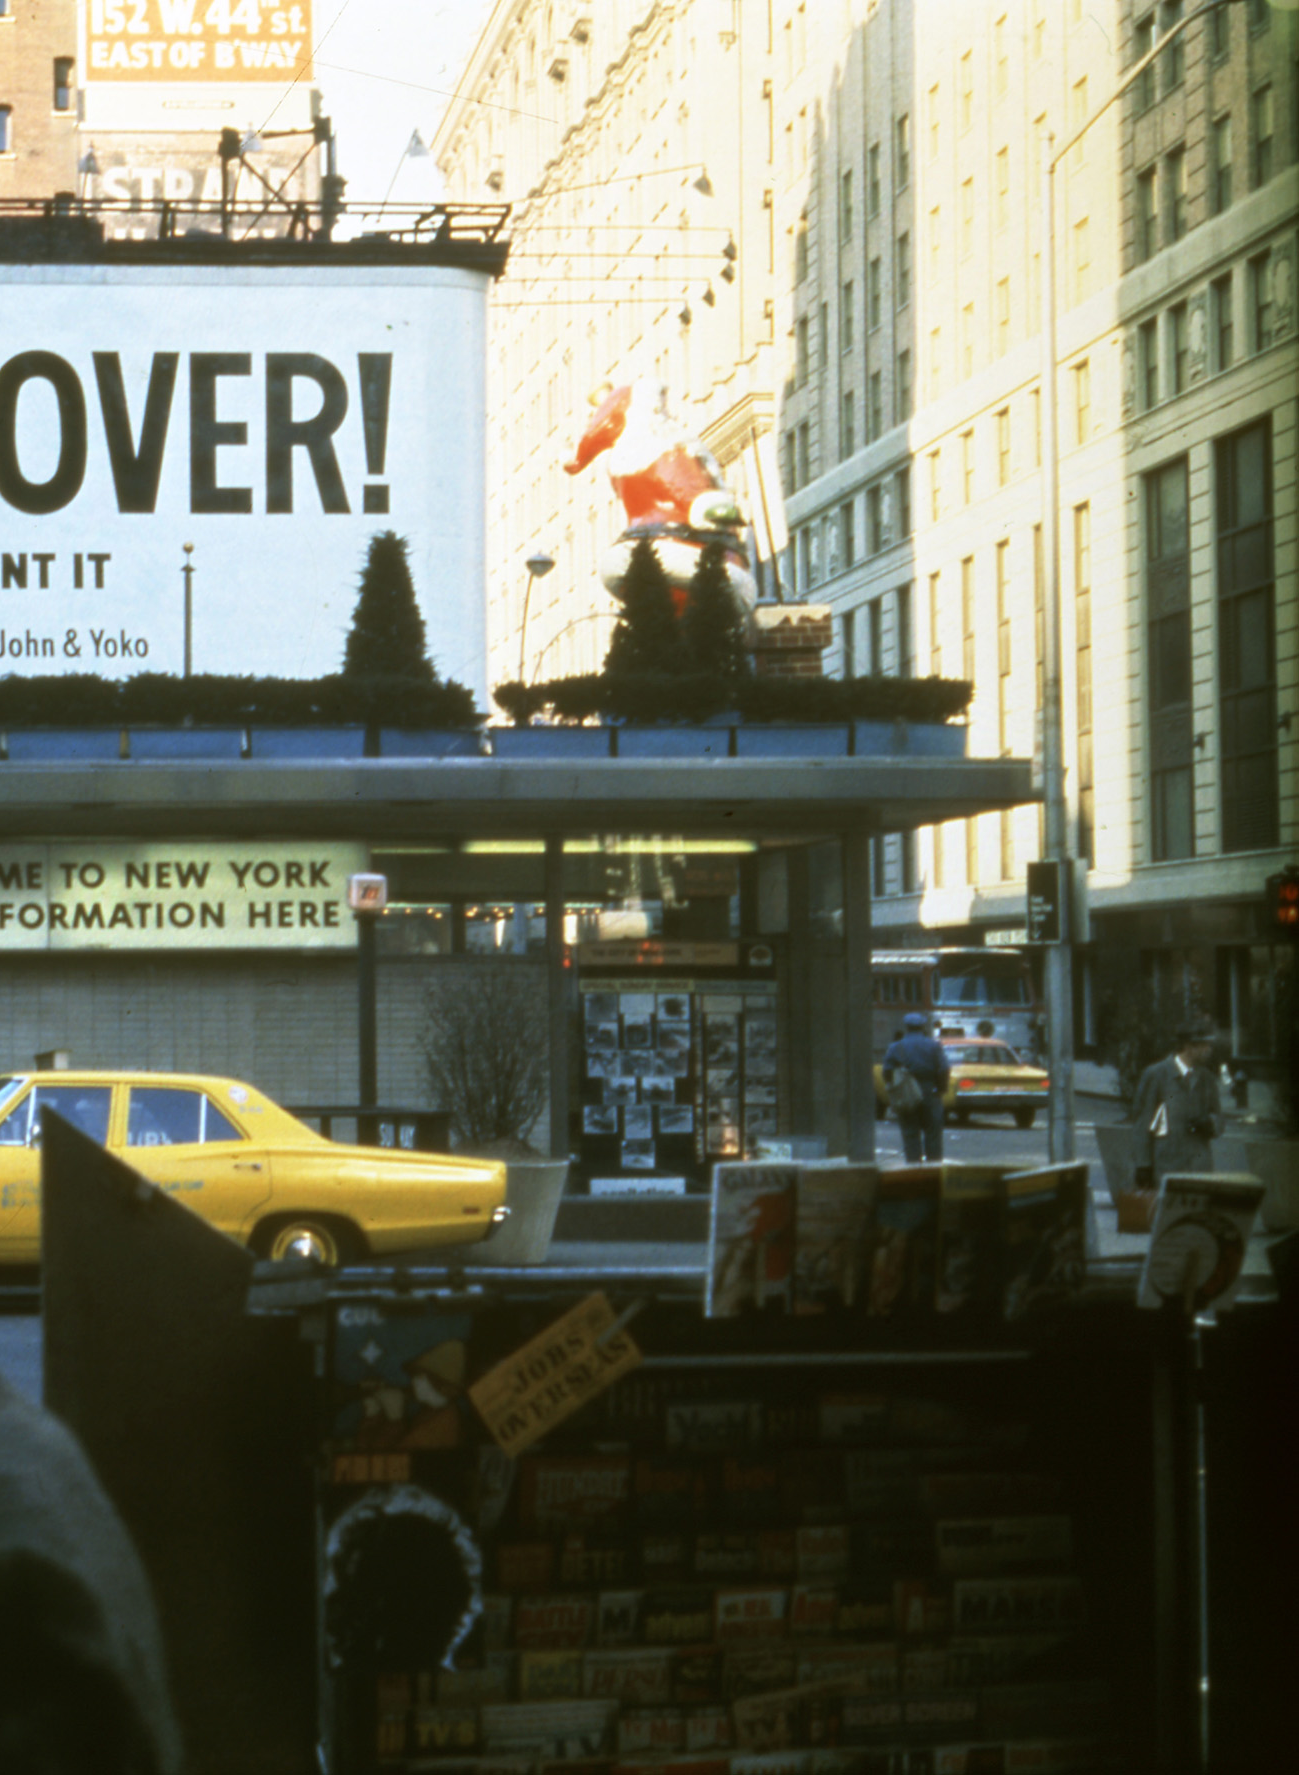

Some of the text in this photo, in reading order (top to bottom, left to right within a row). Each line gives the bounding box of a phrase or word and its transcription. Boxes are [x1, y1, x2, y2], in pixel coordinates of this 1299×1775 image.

[91, 0, 150, 34] 152
[159, 0, 204, 34] W.
[91, 41, 166, 68] EAST
[169, 41, 205, 68] OF
[74, 553, 112, 589] IT
[63, 629, 81, 658] &
[90, 629, 149, 658] Yoko
[60, 862, 107, 889] TO
[125, 862, 209, 889] NEW
[229, 861, 332, 889] YORK
[248, 902, 341, 929] HERE
